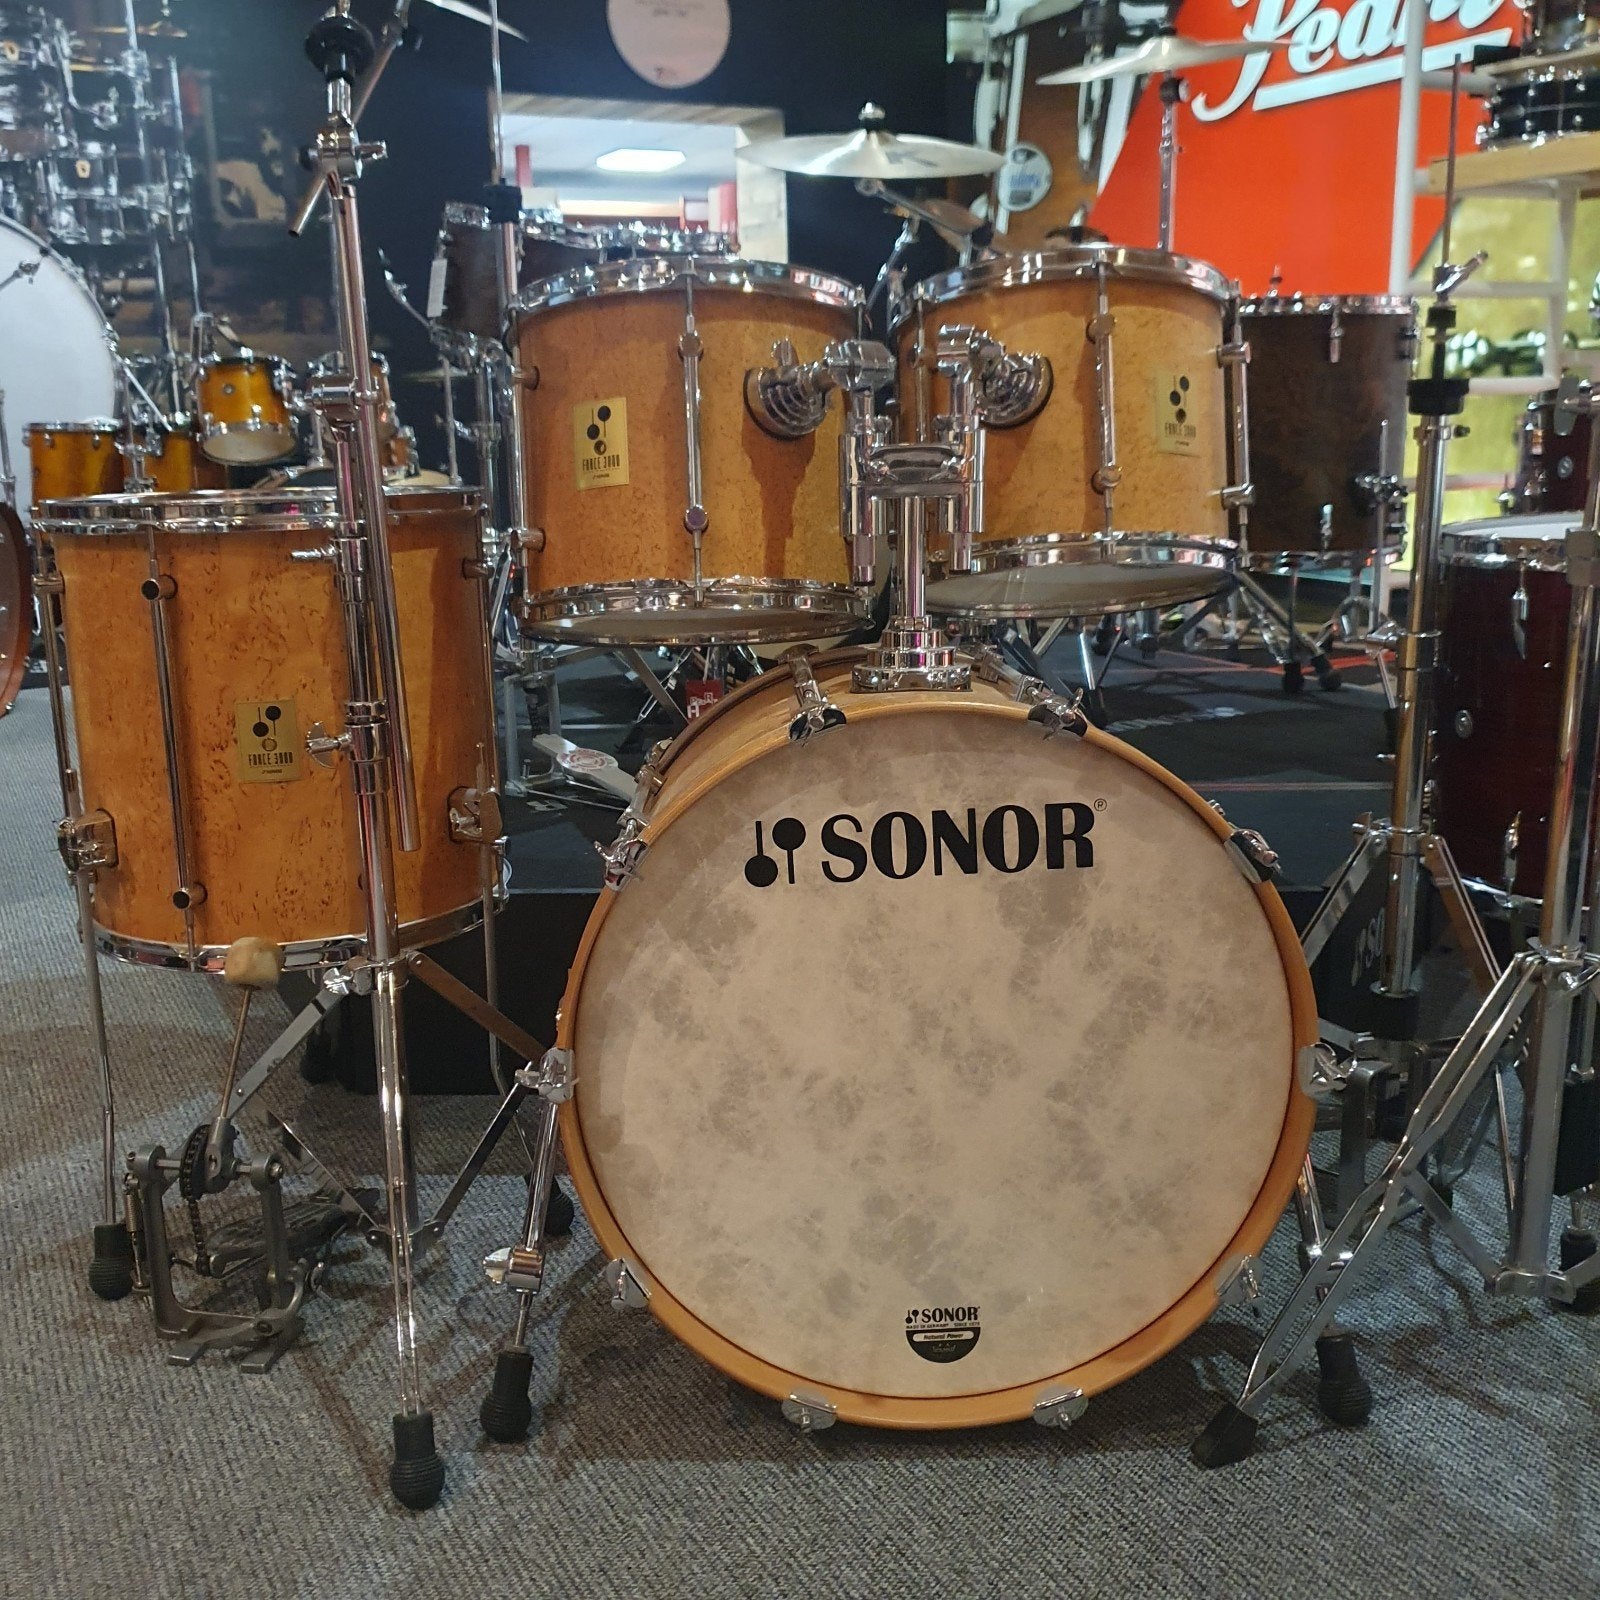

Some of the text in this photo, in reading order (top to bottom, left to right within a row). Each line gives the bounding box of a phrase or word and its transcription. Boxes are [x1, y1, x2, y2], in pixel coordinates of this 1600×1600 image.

[248, 751, 293, 766] FORCE 3000
[821, 802, 1095, 883] SONOR
[921, 1306, 979, 1323] SONOR
